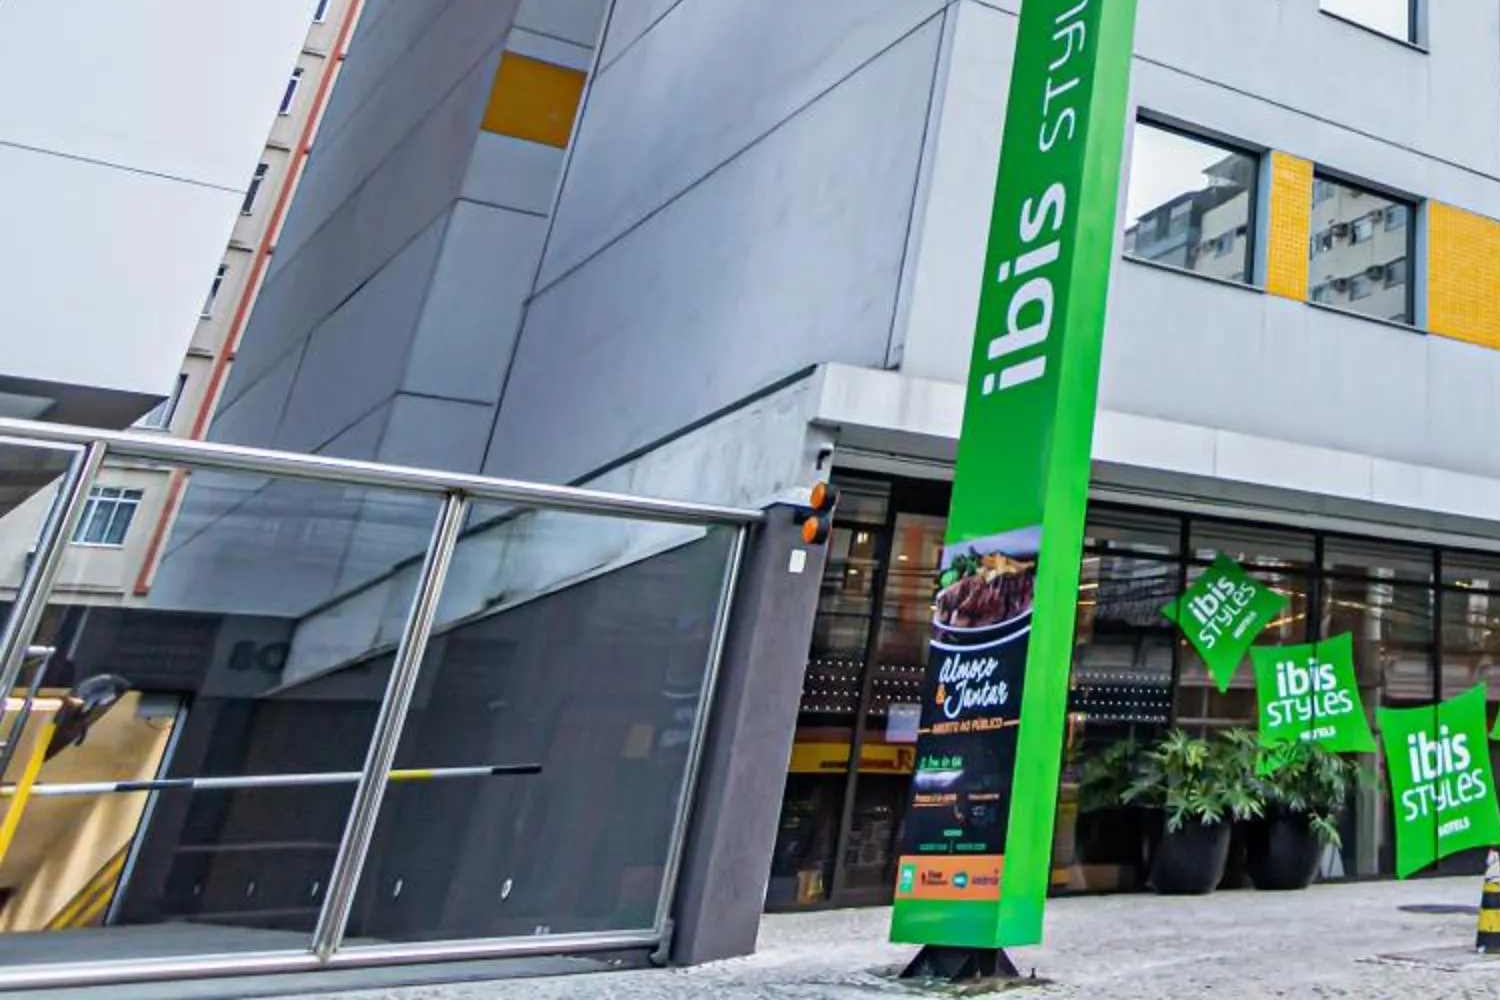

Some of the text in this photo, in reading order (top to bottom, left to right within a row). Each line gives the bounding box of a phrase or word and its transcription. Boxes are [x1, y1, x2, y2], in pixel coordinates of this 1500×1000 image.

[982, 181, 1066, 396] ibis
[1188, 576, 1236, 626] ibis
[944, 680, 1009, 719] Jantar
[1276, 657, 1337, 698] ibis
[1407, 725, 1471, 783] ibis
